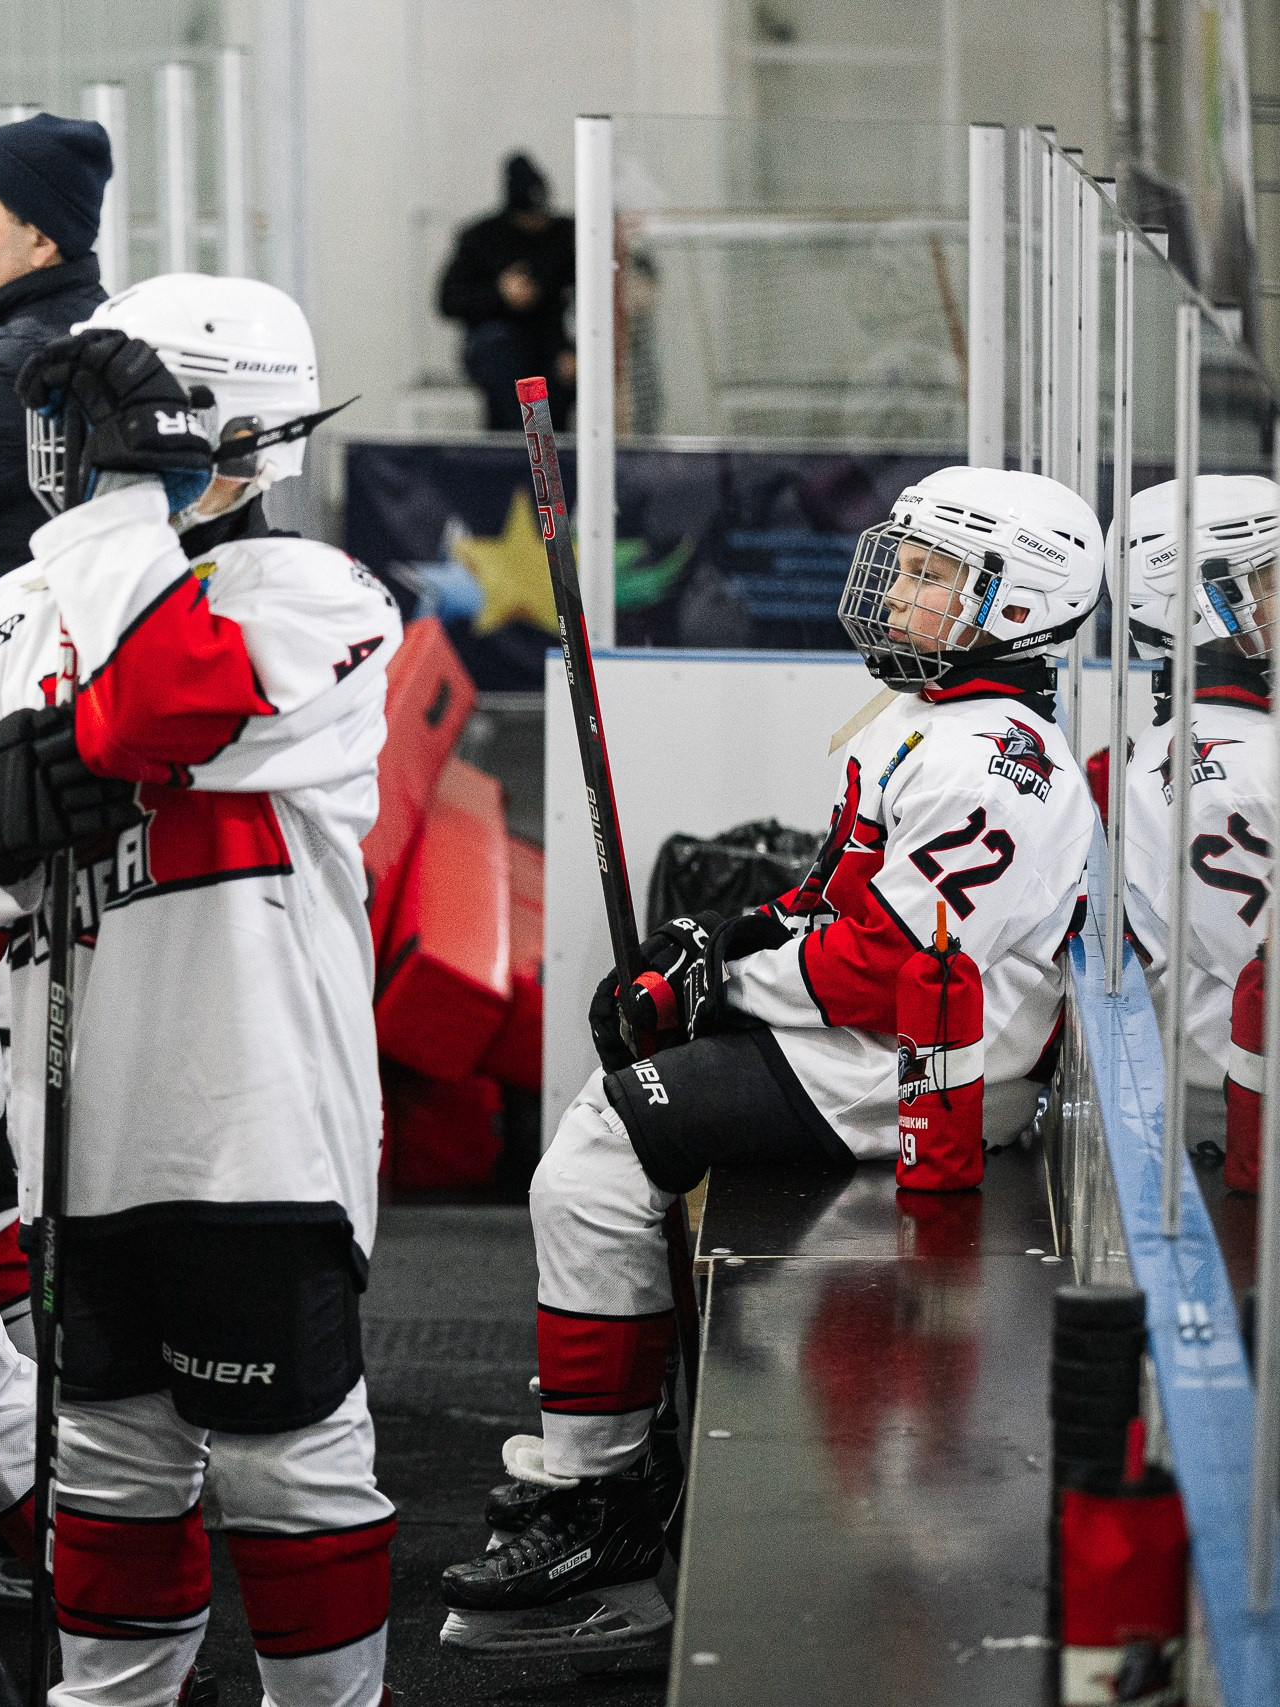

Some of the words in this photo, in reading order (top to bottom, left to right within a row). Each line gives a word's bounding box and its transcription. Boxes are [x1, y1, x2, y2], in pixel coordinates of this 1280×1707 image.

[1017, 534, 1067, 563] BAUER
[990, 756, 1051, 801] СПАРТА
[909, 806, 1016, 921] 22
[47, 981, 67, 1089] BAUER
[900, 1132, 917, 1166] 19
[162, 1342, 275, 1384] BAUER
